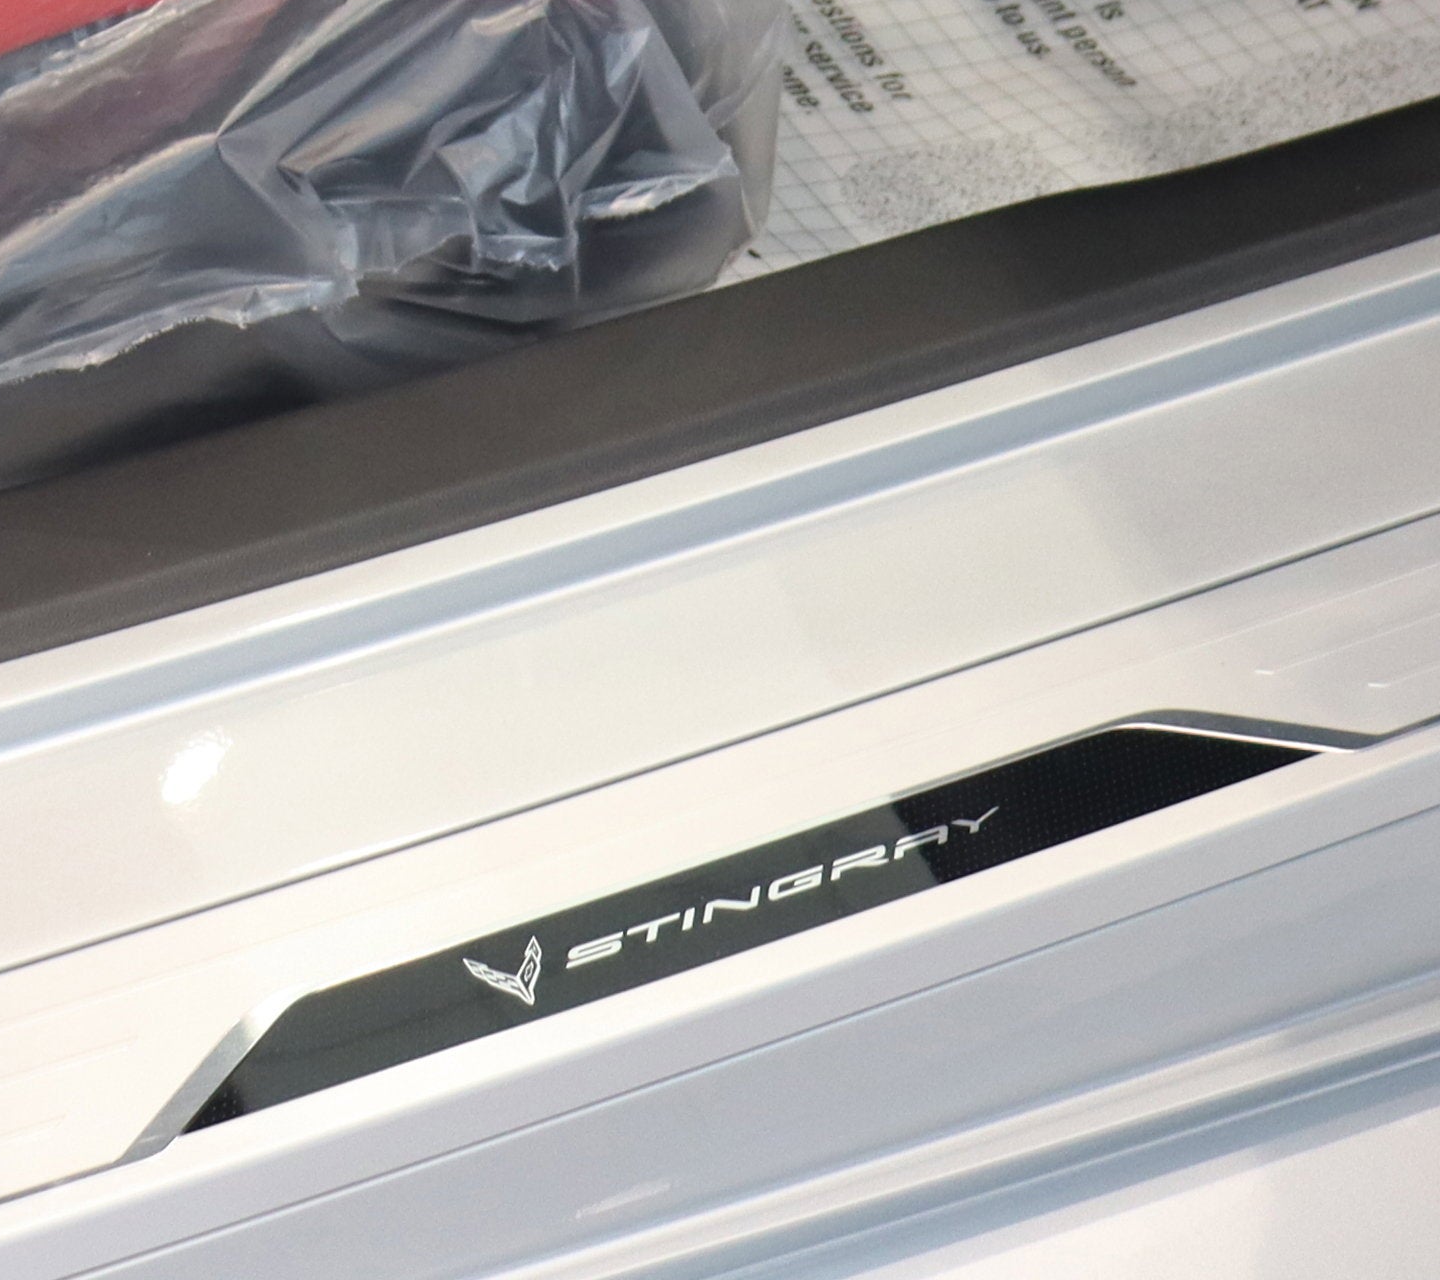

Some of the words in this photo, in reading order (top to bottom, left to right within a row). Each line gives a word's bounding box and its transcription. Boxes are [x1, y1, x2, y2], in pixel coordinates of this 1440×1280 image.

[995, 3, 1026, 26] to
[804, 40, 875, 113] service
[873, 71, 913, 100] for
[1056, 25, 1137, 86] person
[565, 806, 1000, 970] STINGRAY
